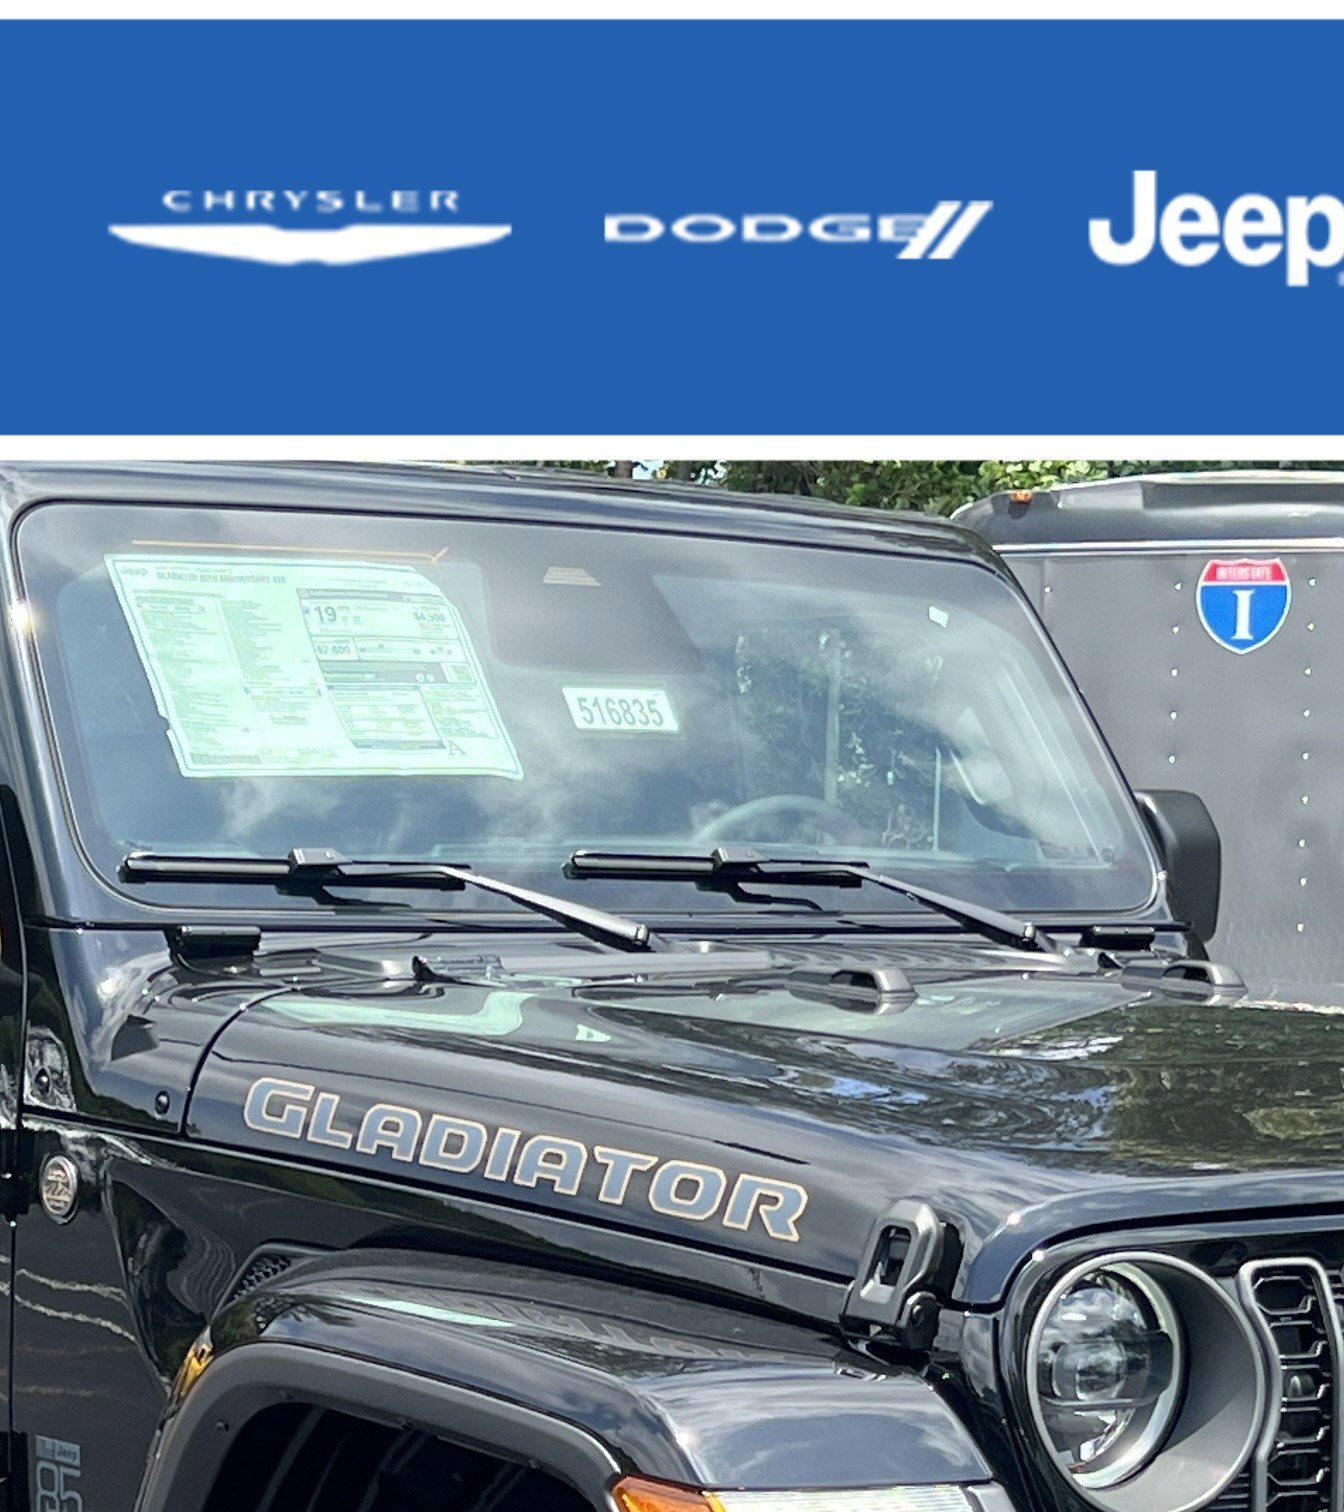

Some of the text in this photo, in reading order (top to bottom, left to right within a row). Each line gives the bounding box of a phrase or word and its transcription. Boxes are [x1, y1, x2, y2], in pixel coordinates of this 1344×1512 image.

[314, 605, 337, 622] 19
[576, 696, 664, 726] 516835
[244, 1076, 808, 1242] GLADIATOR
